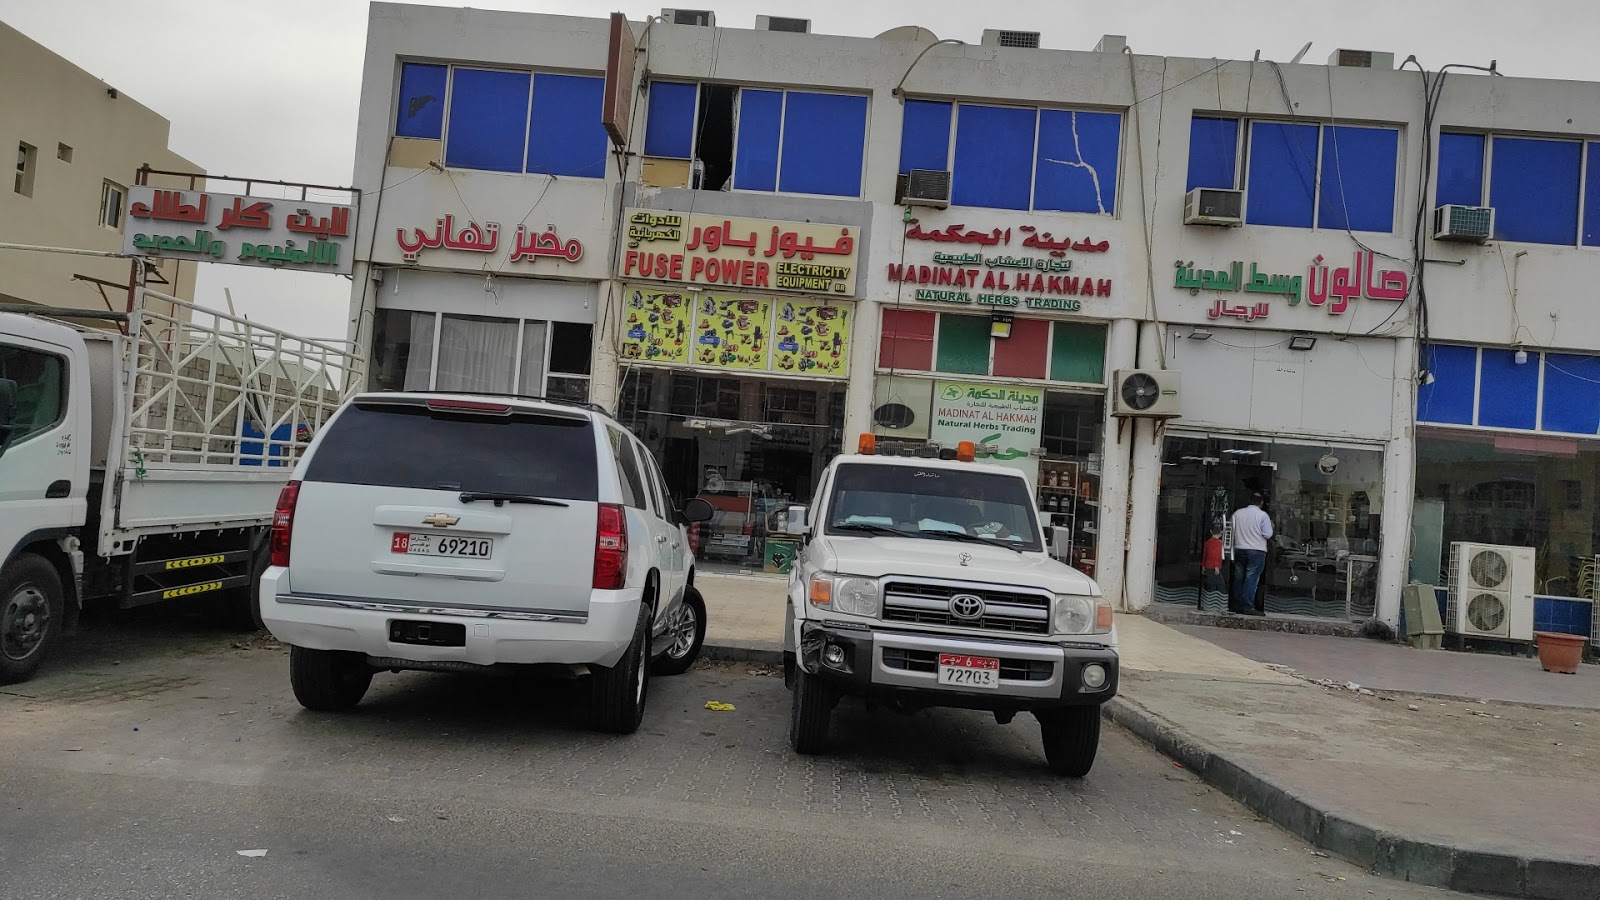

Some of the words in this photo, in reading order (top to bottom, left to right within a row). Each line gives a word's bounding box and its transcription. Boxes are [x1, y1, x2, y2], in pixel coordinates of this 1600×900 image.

[130, 189, 208, 224] لطلاء
[216, 197, 274, 230] كلر
[132, 229, 226, 258] والحديد
[397, 213, 500, 261] تهاني
[509, 223, 584, 262] مخبز
[687, 220, 758, 256] باور
[764, 225, 854, 261] فيوز
[905, 218, 1012, 247] الحكمة
[1019, 225, 1111, 258] مدينة
[624, 250, 683, 280] FUSE
[690, 256, 770, 287] POWER
[776, 262, 851, 280] ELECTRICITY
[888, 263, 979, 288] MADINAT
[982, 270, 1011, 291] AL
[1016, 273, 1112, 298] HAKMAH
[1173, 259, 1244, 296] المدينة
[1306, 250, 1408, 315] صالون
[776, 277, 832, 291] EQUIPMENT
[835, 283, 847, 292] BR
[1244, 262, 1303, 306] وسط
[915, 289, 972, 304] NATURAL
[977, 293, 1020, 307] HERBS
[1026, 297, 1081, 311] TRADING
[1207, 300, 1271, 322] للرجال
[967, 387, 1006, 401] الحكمة
[1007, 389, 1039, 405] مدينة
[937, 419, 971, 428] Natural
[973, 423, 999, 431] Herbs
[1002, 424, 1036, 435] Trading
[938, 407, 980, 418] MADINAT
[982, 411, 994, 420] AL
[996, 412, 1037, 424] HAKMAH
[394, 537, 408, 549] 18
[438, 538, 489, 556] 69210
[966, 656, 973, 667] 6
[947, 668, 990, 685] 72703
